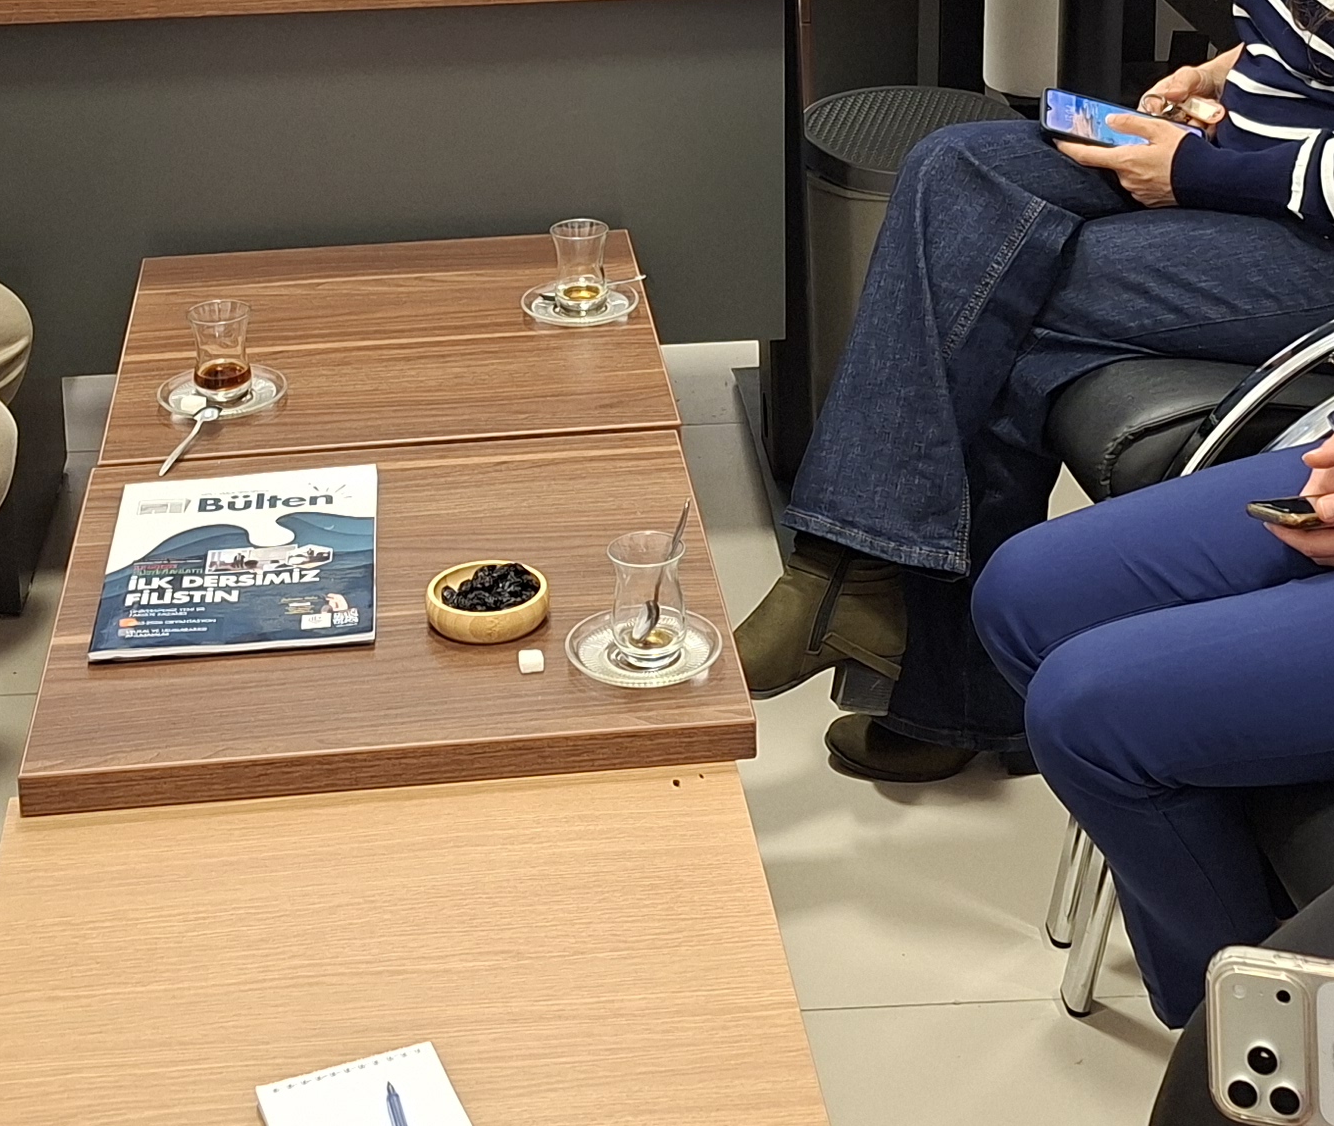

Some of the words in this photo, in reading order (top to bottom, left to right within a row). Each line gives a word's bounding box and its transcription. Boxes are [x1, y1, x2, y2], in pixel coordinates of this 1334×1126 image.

[197, 493, 334, 513] Bülten
[128, 575, 174, 592] İLK
[180, 568, 321, 589] DERSİMİZ
[124, 588, 240, 607] FİLİSTİN
